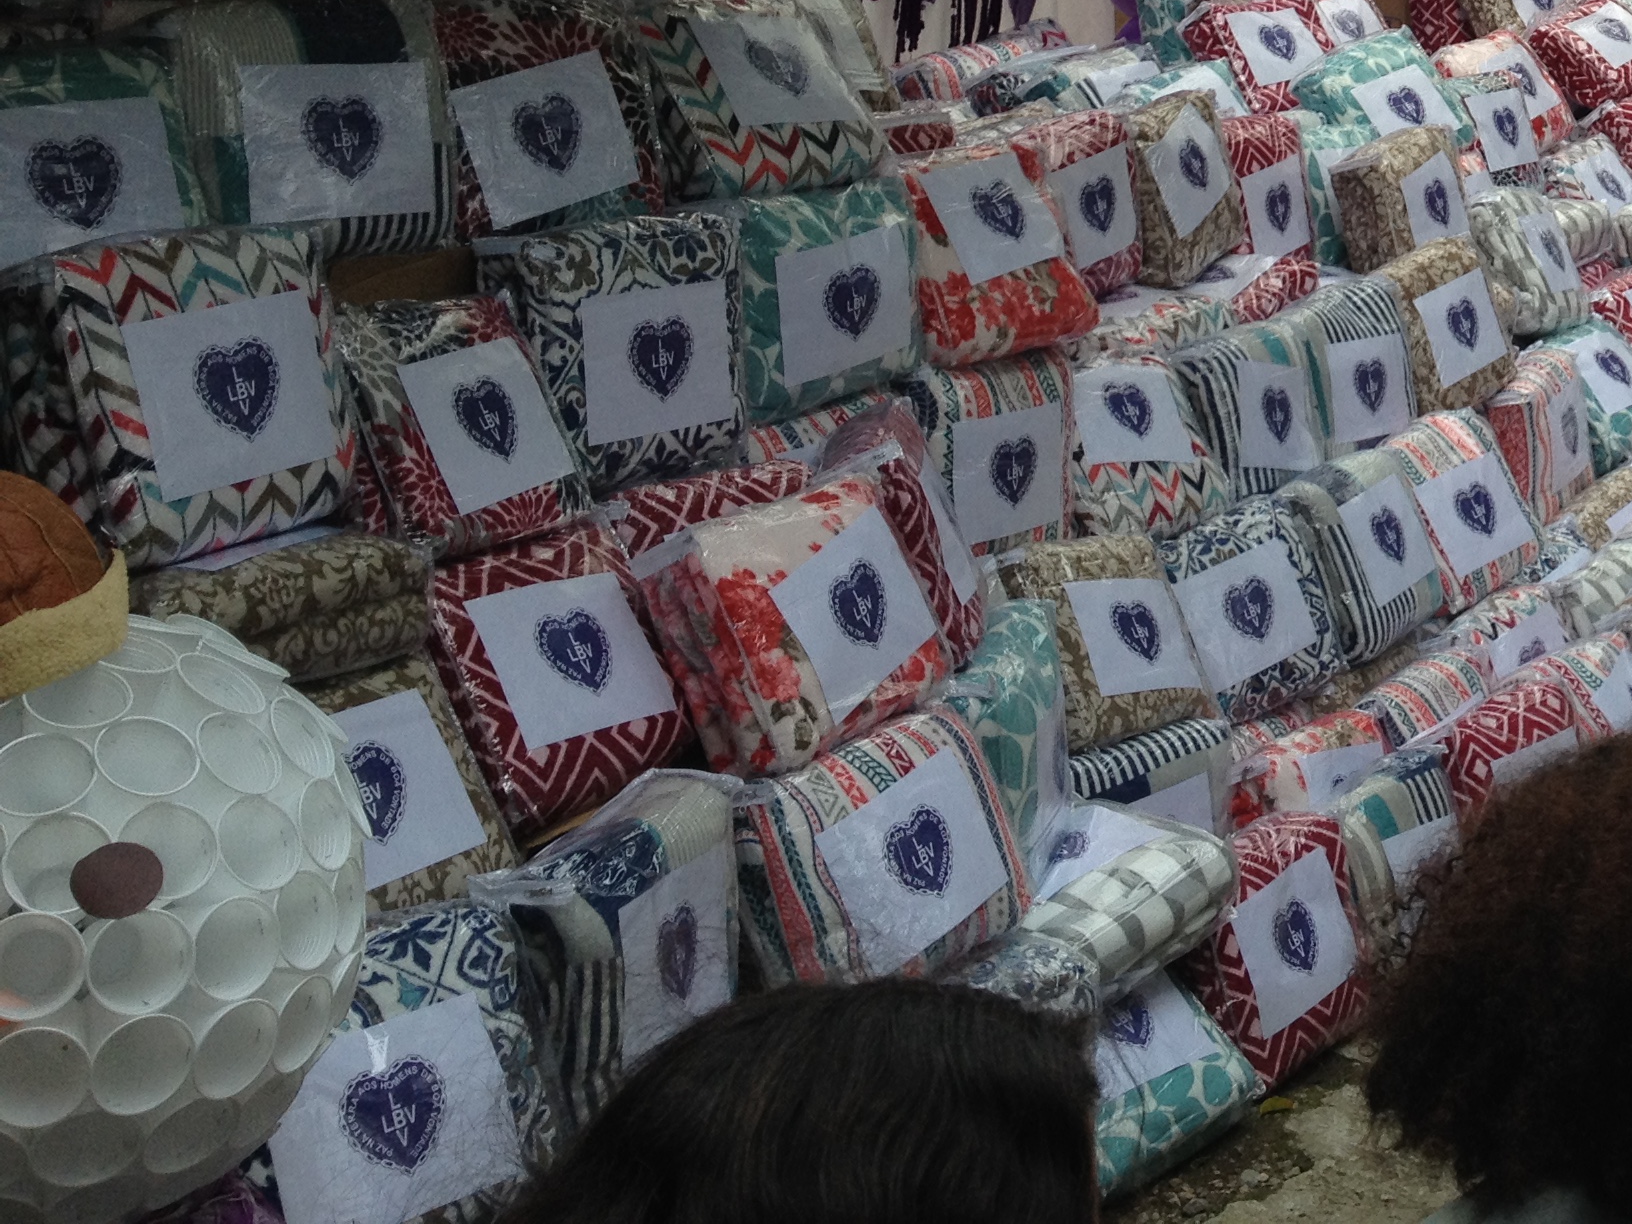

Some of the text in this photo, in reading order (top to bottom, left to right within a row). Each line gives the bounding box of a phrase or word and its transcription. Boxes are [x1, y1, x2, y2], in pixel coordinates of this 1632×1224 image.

[350, 749, 378, 771] OMENS
[357, 1080, 378, 1096] AOS
[380, 1065, 419, 1090] HOMENS
